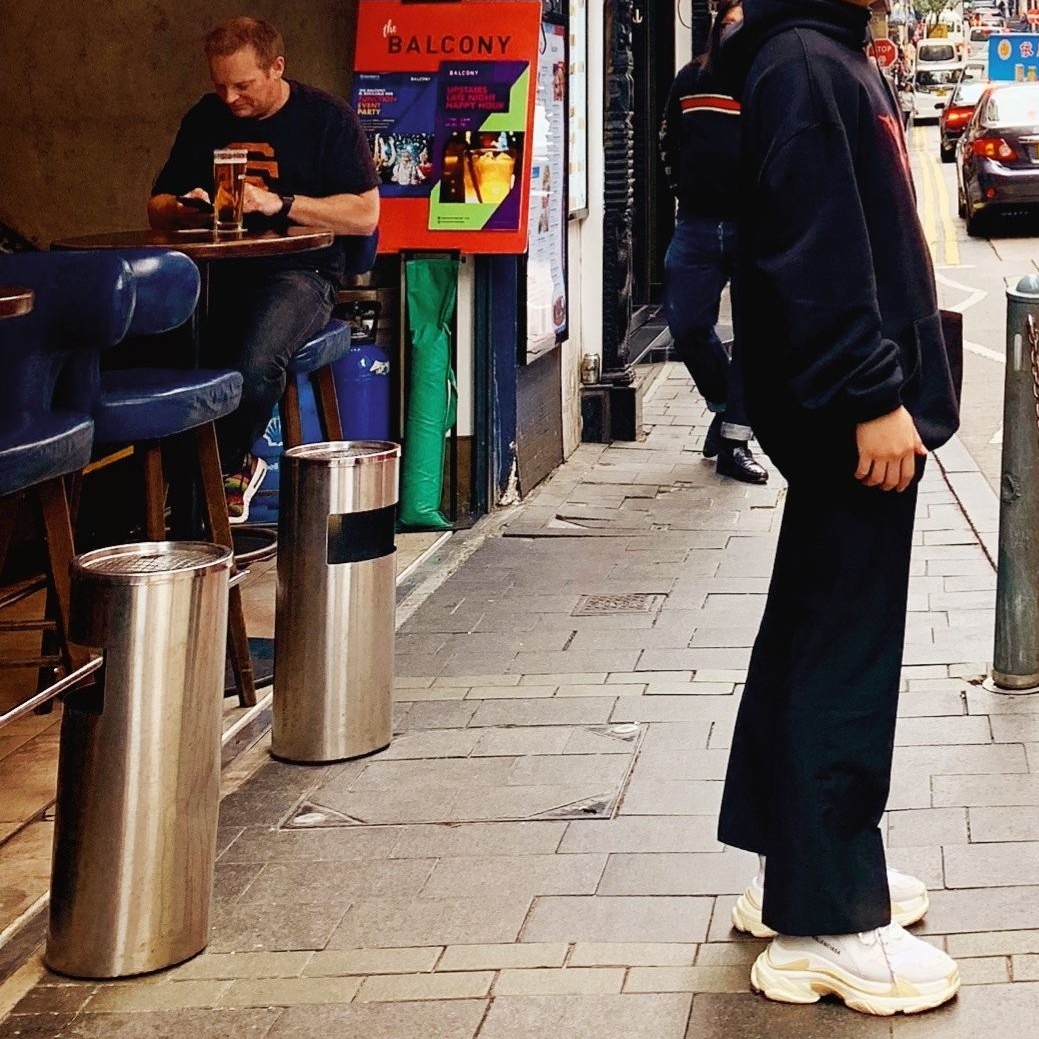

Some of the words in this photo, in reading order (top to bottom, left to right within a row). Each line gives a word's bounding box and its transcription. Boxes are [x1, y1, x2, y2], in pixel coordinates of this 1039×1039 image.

[383, 19, 397, 38] the
[388, 35, 512, 55] BALCONY
[357, 108, 381, 116] PARTY
[446, 102, 476, 110] HAPPY
